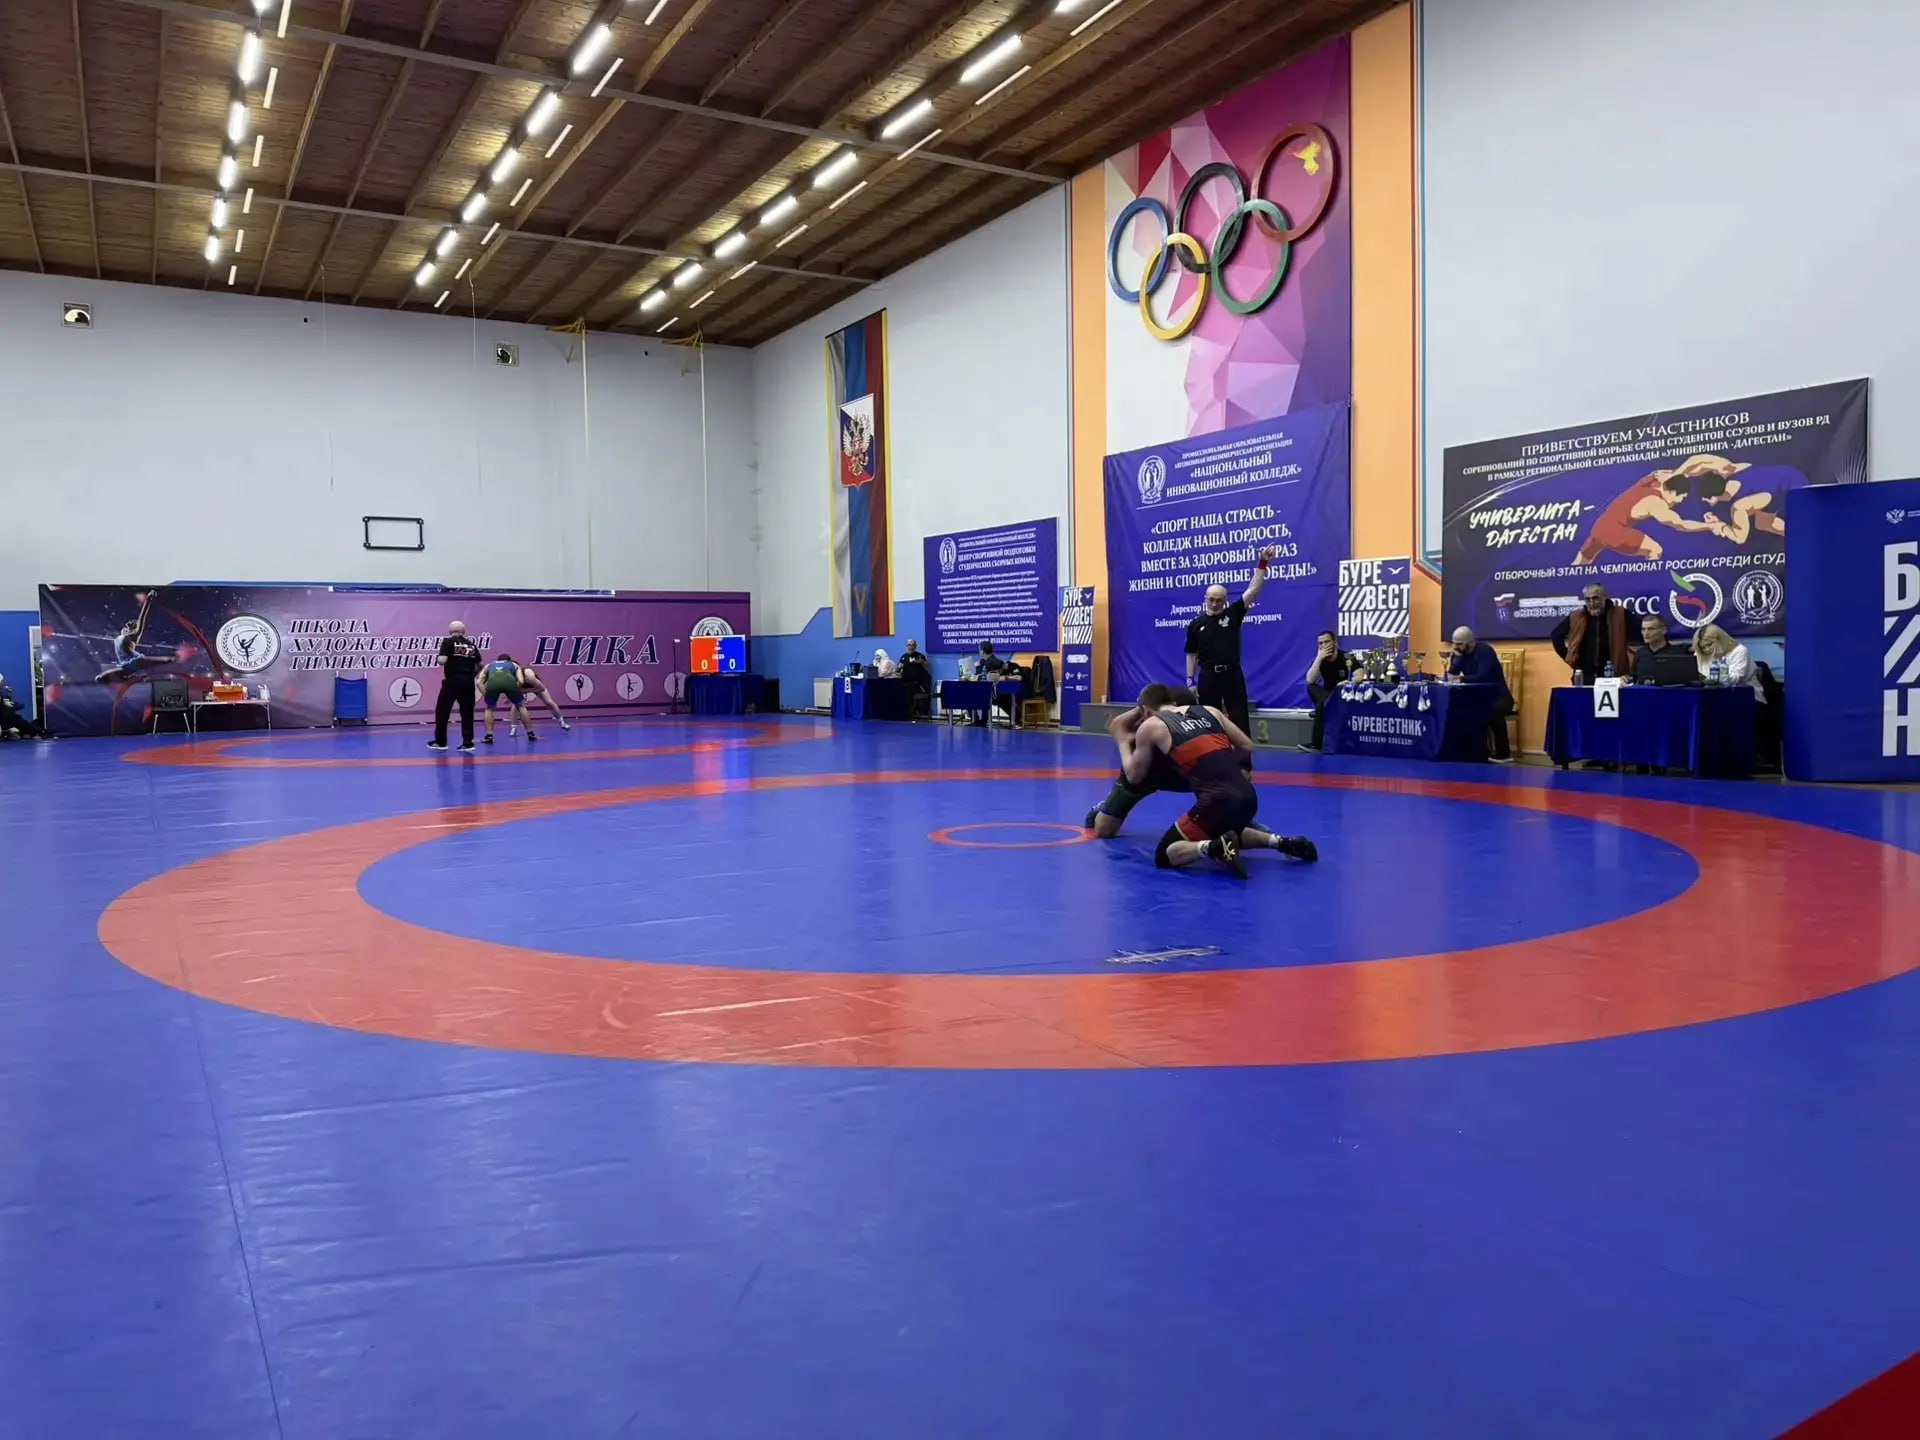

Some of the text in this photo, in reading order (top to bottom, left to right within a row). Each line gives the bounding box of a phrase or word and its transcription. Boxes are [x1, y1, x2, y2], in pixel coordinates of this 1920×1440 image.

[1462, 414, 1831, 476] СОРЕВНОВАНИЙ ПО СПОРТИВНОЙ БОРЬБЕ СРЕДИ СТУДЕНТОВ ССУЗОВ И ВУЗОВ РД
[1522, 411, 1750, 457] ПРИВЕТСТВУЕМ УЧАСТНИКОВ
[1190, 451, 1272, 479] «НАЦИОНАЛЬНЫЙ
[1494, 468, 1525, 480] РАМКАХ
[1526, 458, 1592, 476] РЕГИОНАЛЬНОЙ
[1593, 449, 1660, 467] СПАРТАКИАДЫ
[1661, 441, 1729, 458] «УНИВЕРЛИГА
[1166, 464, 1302, 498] ИННОВАЦИОННЫЙ КОЛЛЕДЖ»
[1151, 517, 1189, 535] «СПОРТ
[1190, 513, 1223, 530] НАША
[1225, 504, 1274, 525] СТРАСТЬ
[1469, 499, 1580, 529] УНИВЕРЛИГА
[1143, 523, 1291, 555] КОЛЛЕДЖ НАША ГОРДОСТЬ,
[1486, 523, 1578, 548] ДАГЕСТАН
[1141, 554, 1177, 573] ВМЕСТЕ
[1178, 553, 1191, 569] ЗА
[1192, 545, 1256, 569] ЗДОРОВЫЙ
[1494, 566, 1556, 581] ОТБОРОЧНЫЙ
[1557, 565, 1583, 577] ЭТАП
[1584, 565, 1599, 575] НА
[1600, 560, 1663, 575] ЧЕМПИОНАТ
[1665, 558, 1709, 571] РОССИИ
[1711, 555, 1751, 568] СРЕДИ
[1129, 576, 1165, 592] ЖИЗНИ
[1166, 576, 1173, 589] И
[1174, 567, 1251, 588] СПОРТИВНЫЕ
[1339, 561, 1383, 587] БУРЕ
[1883, 540, 1920, 613] Б
[1064, 588, 1083, 607] БУРЕ
[1170, 603, 1202, 616] Директор
[1365, 583, 1411, 610] ВЕСТ
[288, 618, 370, 635] ШКОЛА
[1338, 611, 1374, 637] НИК
[290, 655, 442, 672] ГИМНАСТИКИ
[531, 634, 659, 667] НИКА
[701, 658, 736, 670] 0 0
[1598, 690, 1615, 712] A
[1257, 719, 1269, 743] 3
[1351, 715, 1422, 737] БУРЕВЕСТНИК
